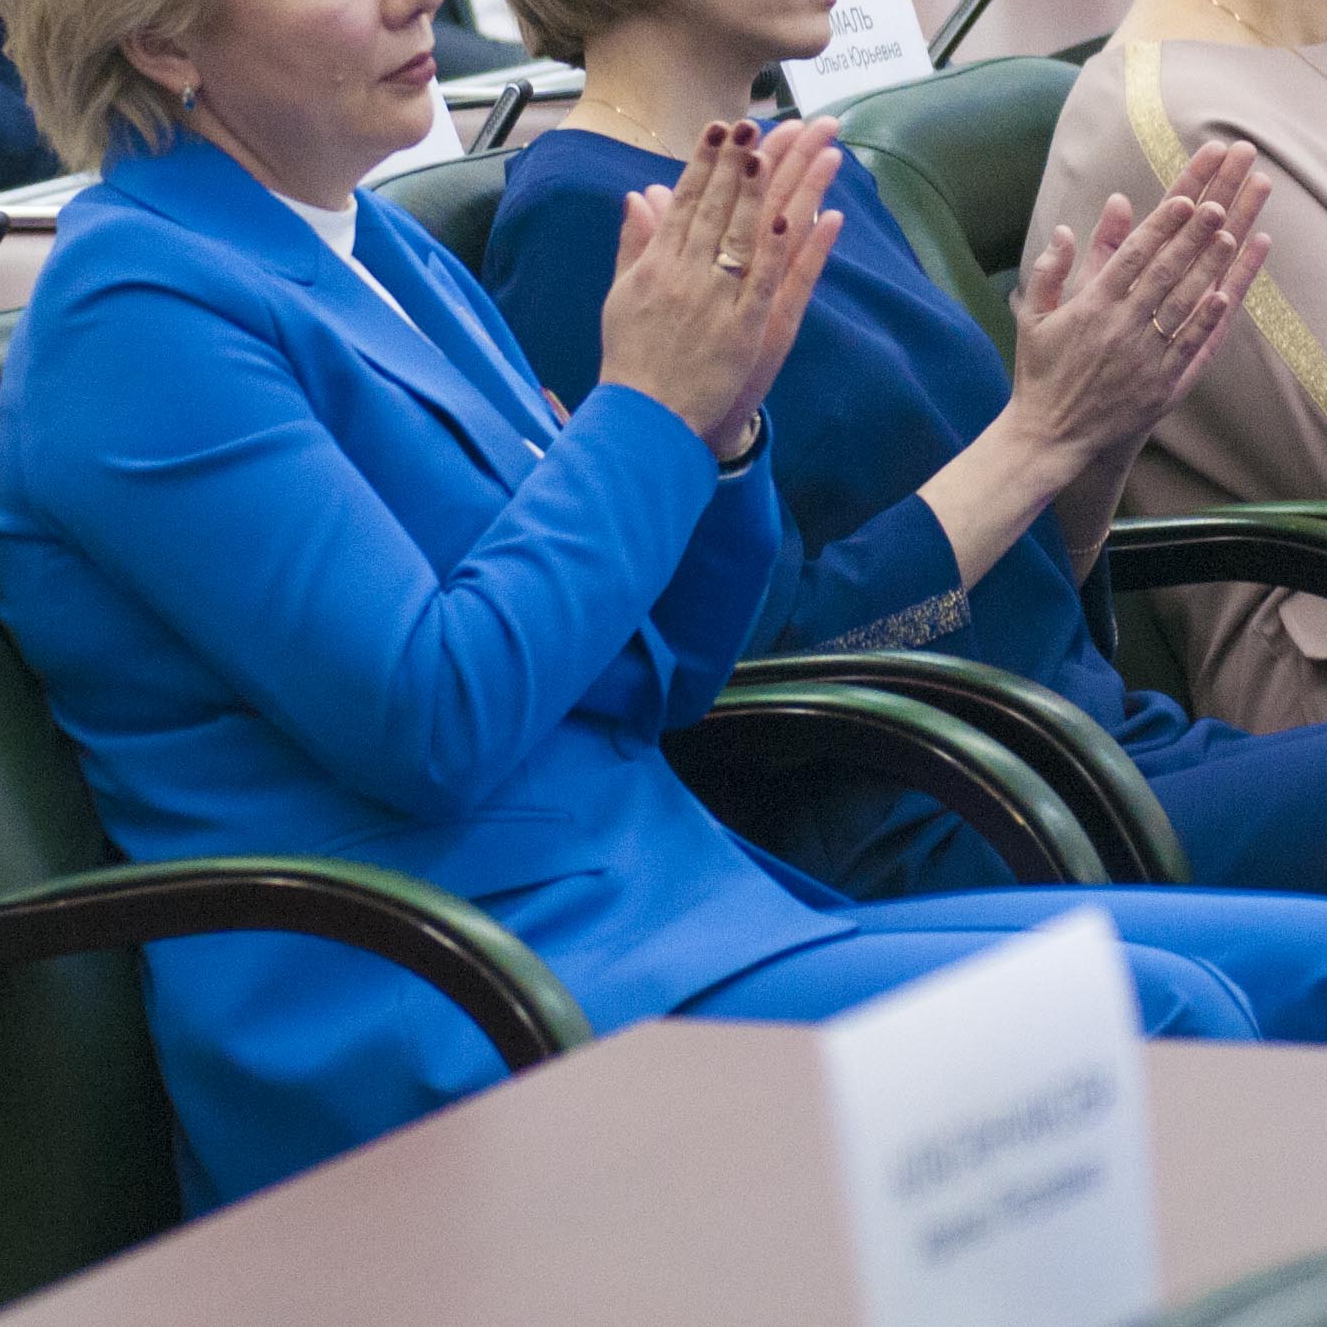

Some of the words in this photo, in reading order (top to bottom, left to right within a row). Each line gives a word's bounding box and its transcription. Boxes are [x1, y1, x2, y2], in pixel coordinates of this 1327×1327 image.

[827, 6, 874, 37] МАЛЬ
[815, 53, 849, 75] Ольга
[847, 42, 903, 71] Юрьевна
